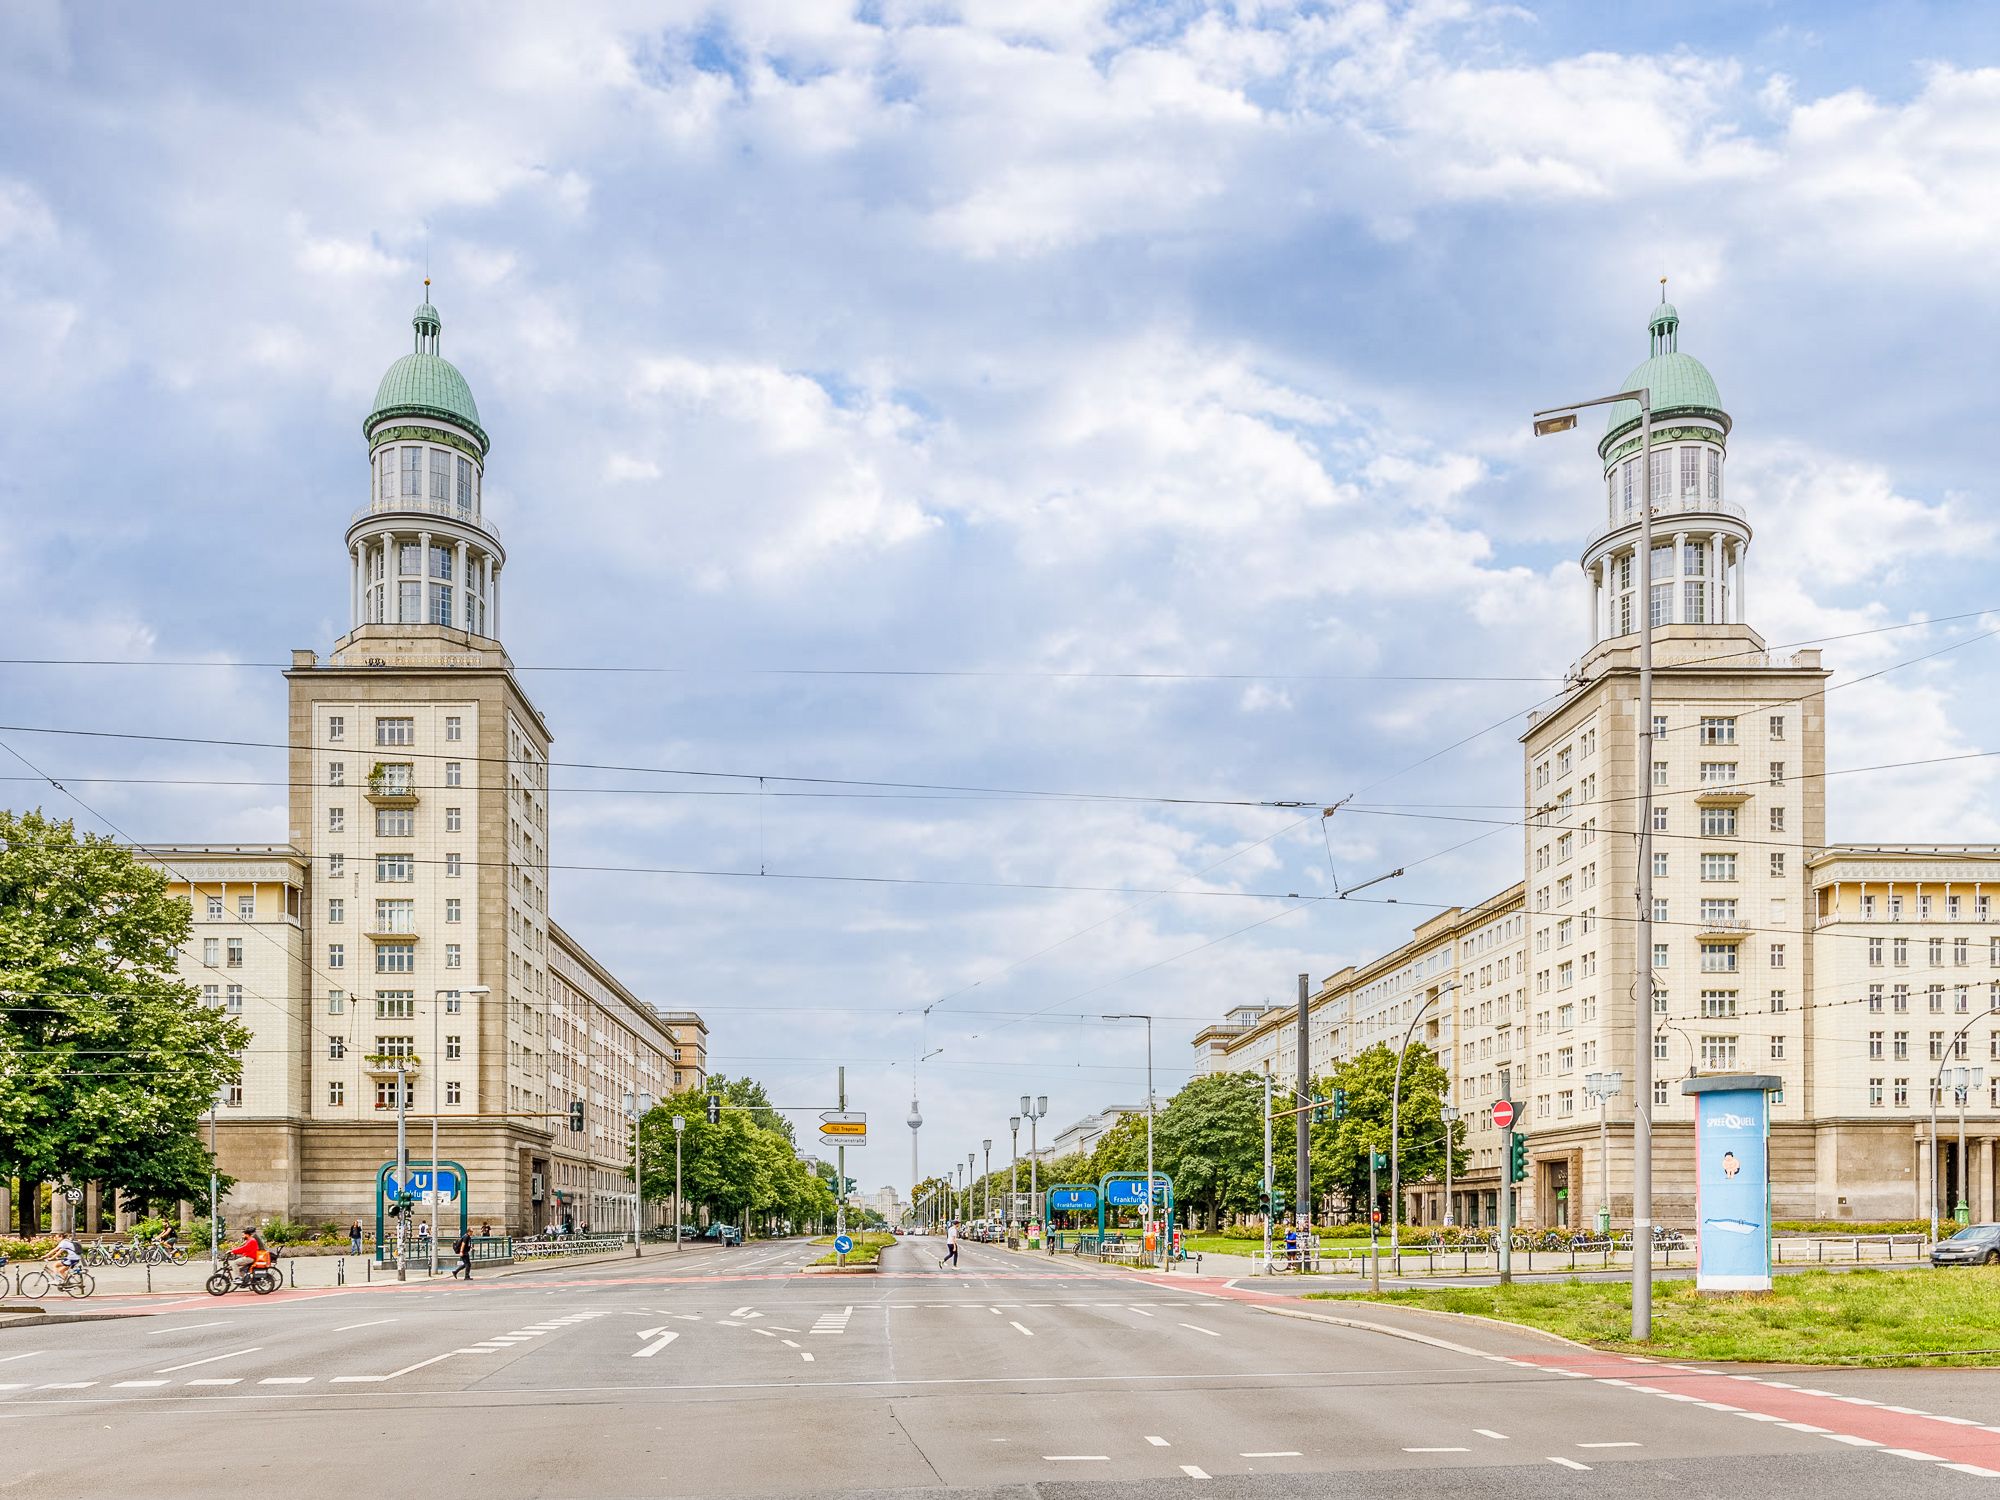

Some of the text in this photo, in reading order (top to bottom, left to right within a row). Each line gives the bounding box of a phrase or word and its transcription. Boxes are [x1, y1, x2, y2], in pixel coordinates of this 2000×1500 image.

[415, 1174, 427, 1189] U
[1132, 1183, 1142, 1195] U
[1070, 1192, 1079, 1202] U
